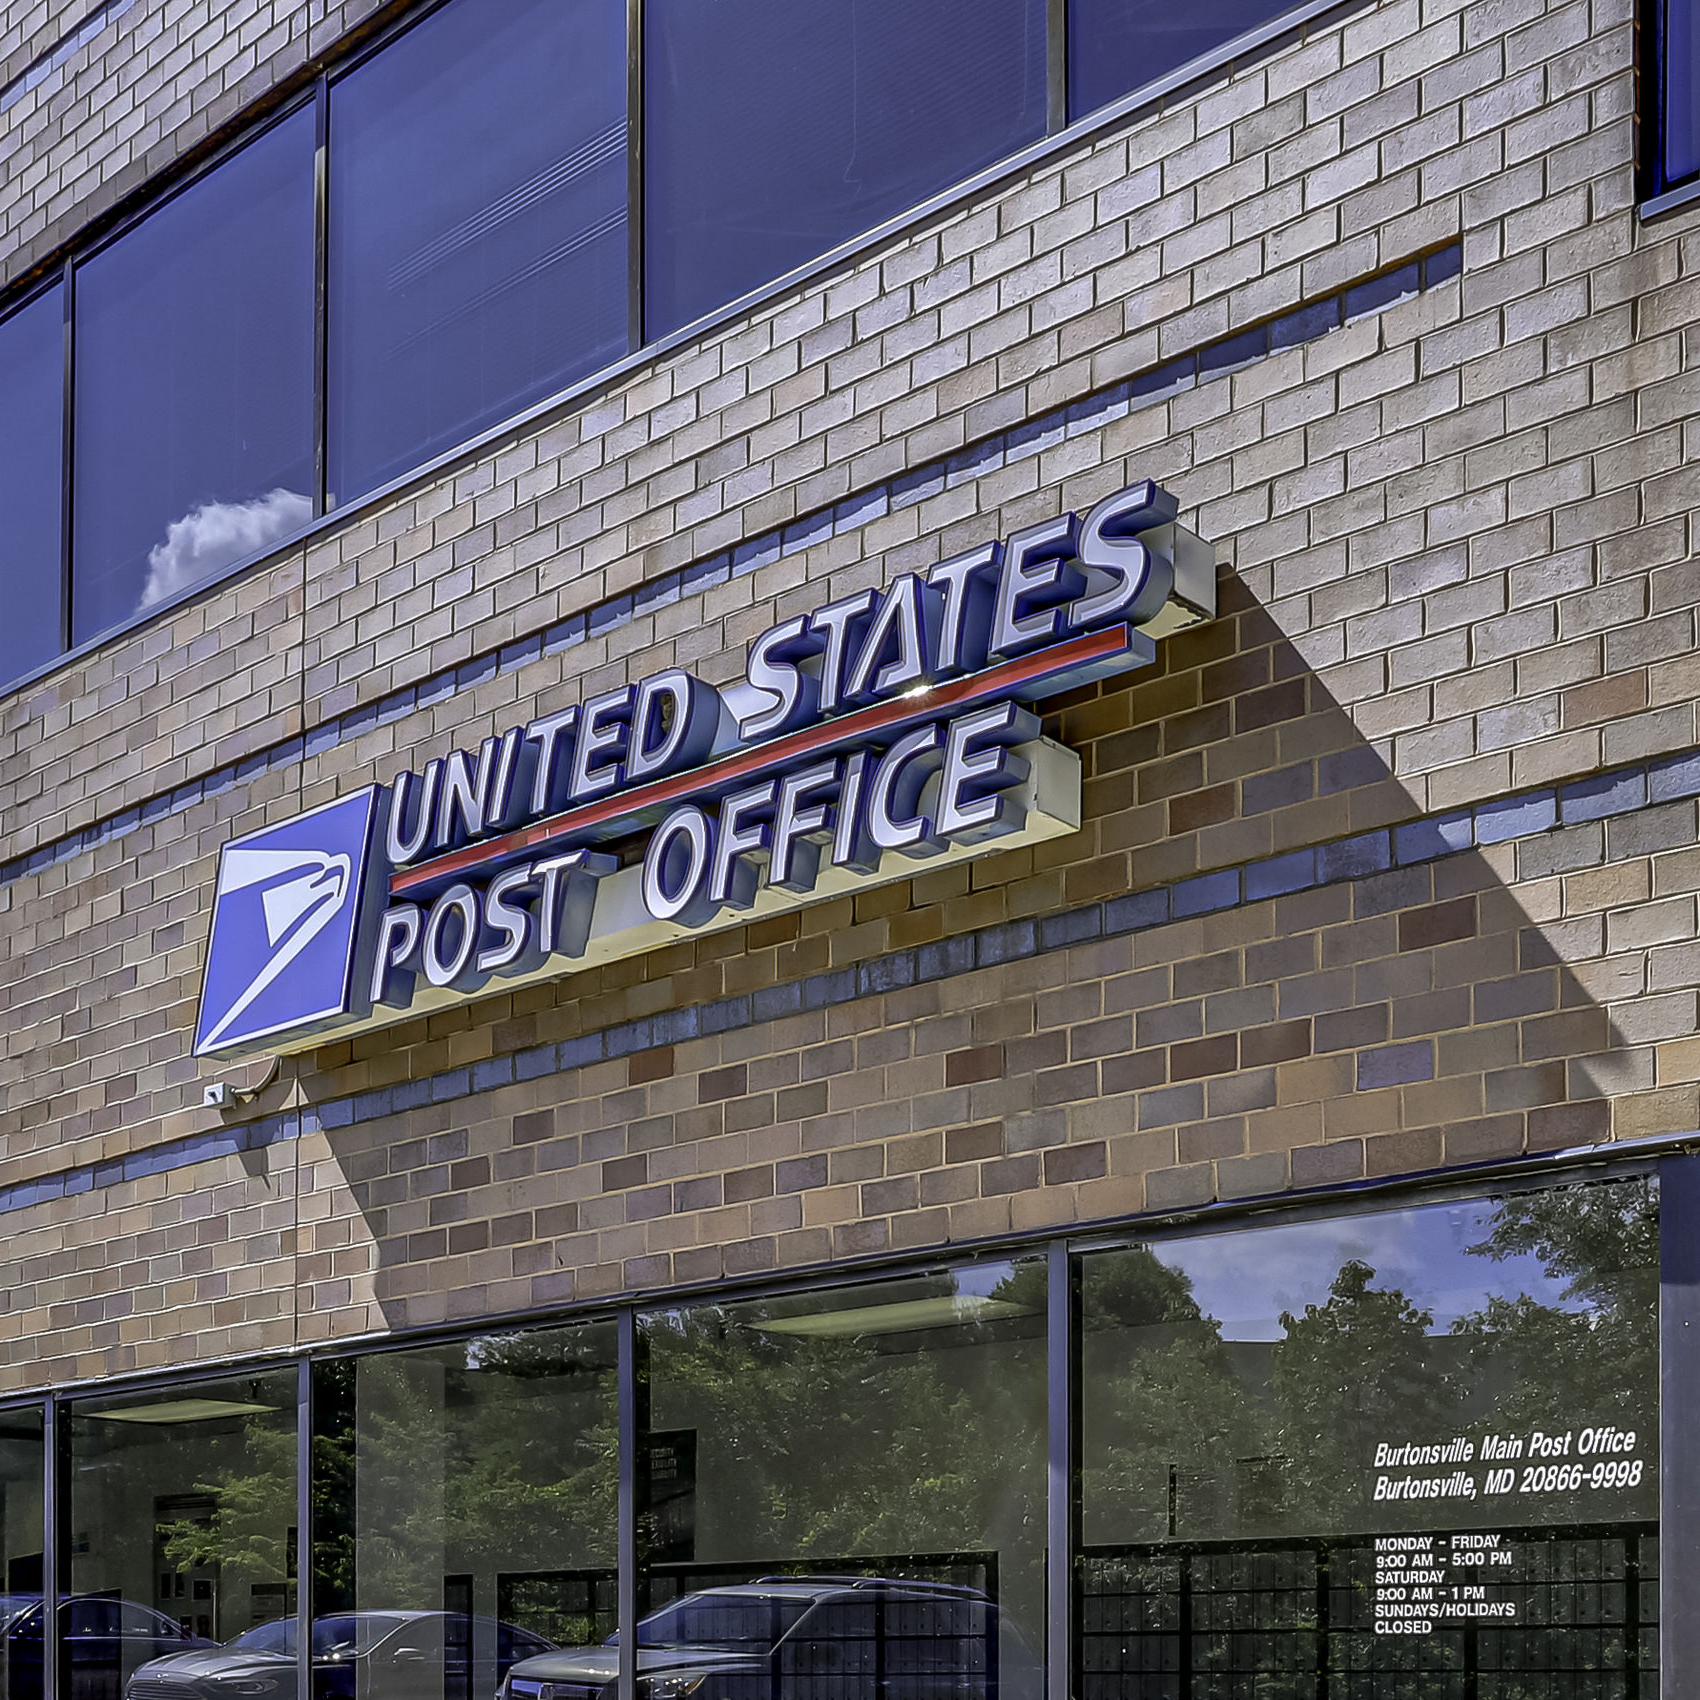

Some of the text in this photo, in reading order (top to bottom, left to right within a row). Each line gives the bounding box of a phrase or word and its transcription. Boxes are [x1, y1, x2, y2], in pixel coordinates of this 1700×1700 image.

[386, 478, 1157, 864] UNITED STATES
[370, 700, 1017, 1003] POST OFFICE
[1374, 1427, 1636, 1467] Burtonsville Main Post Office
[1374, 1460, 1643, 1500] Burtonsville, MD 20866-9998
[1375, 1537, 1433, 1551] MONDAY
[1452, 1535, 1500, 1549] FRIDAY
[1377, 1555, 1406, 1568] 9:00
[1412, 1554, 1433, 1567] AM
[1452, 1552, 1484, 1565] 5:00
[1490, 1552, 1511, 1565] PM
[1375, 1570, 1445, 1584] SATURDAY
[1377, 1588, 1406, 1600] 9:00
[1412, 1587, 1433, 1600] AM
[1452, 1587, 1458, 1599] 1
[1464, 1586, 1485, 1599] PM
[1375, 1603, 1515, 1617] SUNDAYS/HOLIDAYS
[1375, 1621, 1431, 1634] CLOSED
